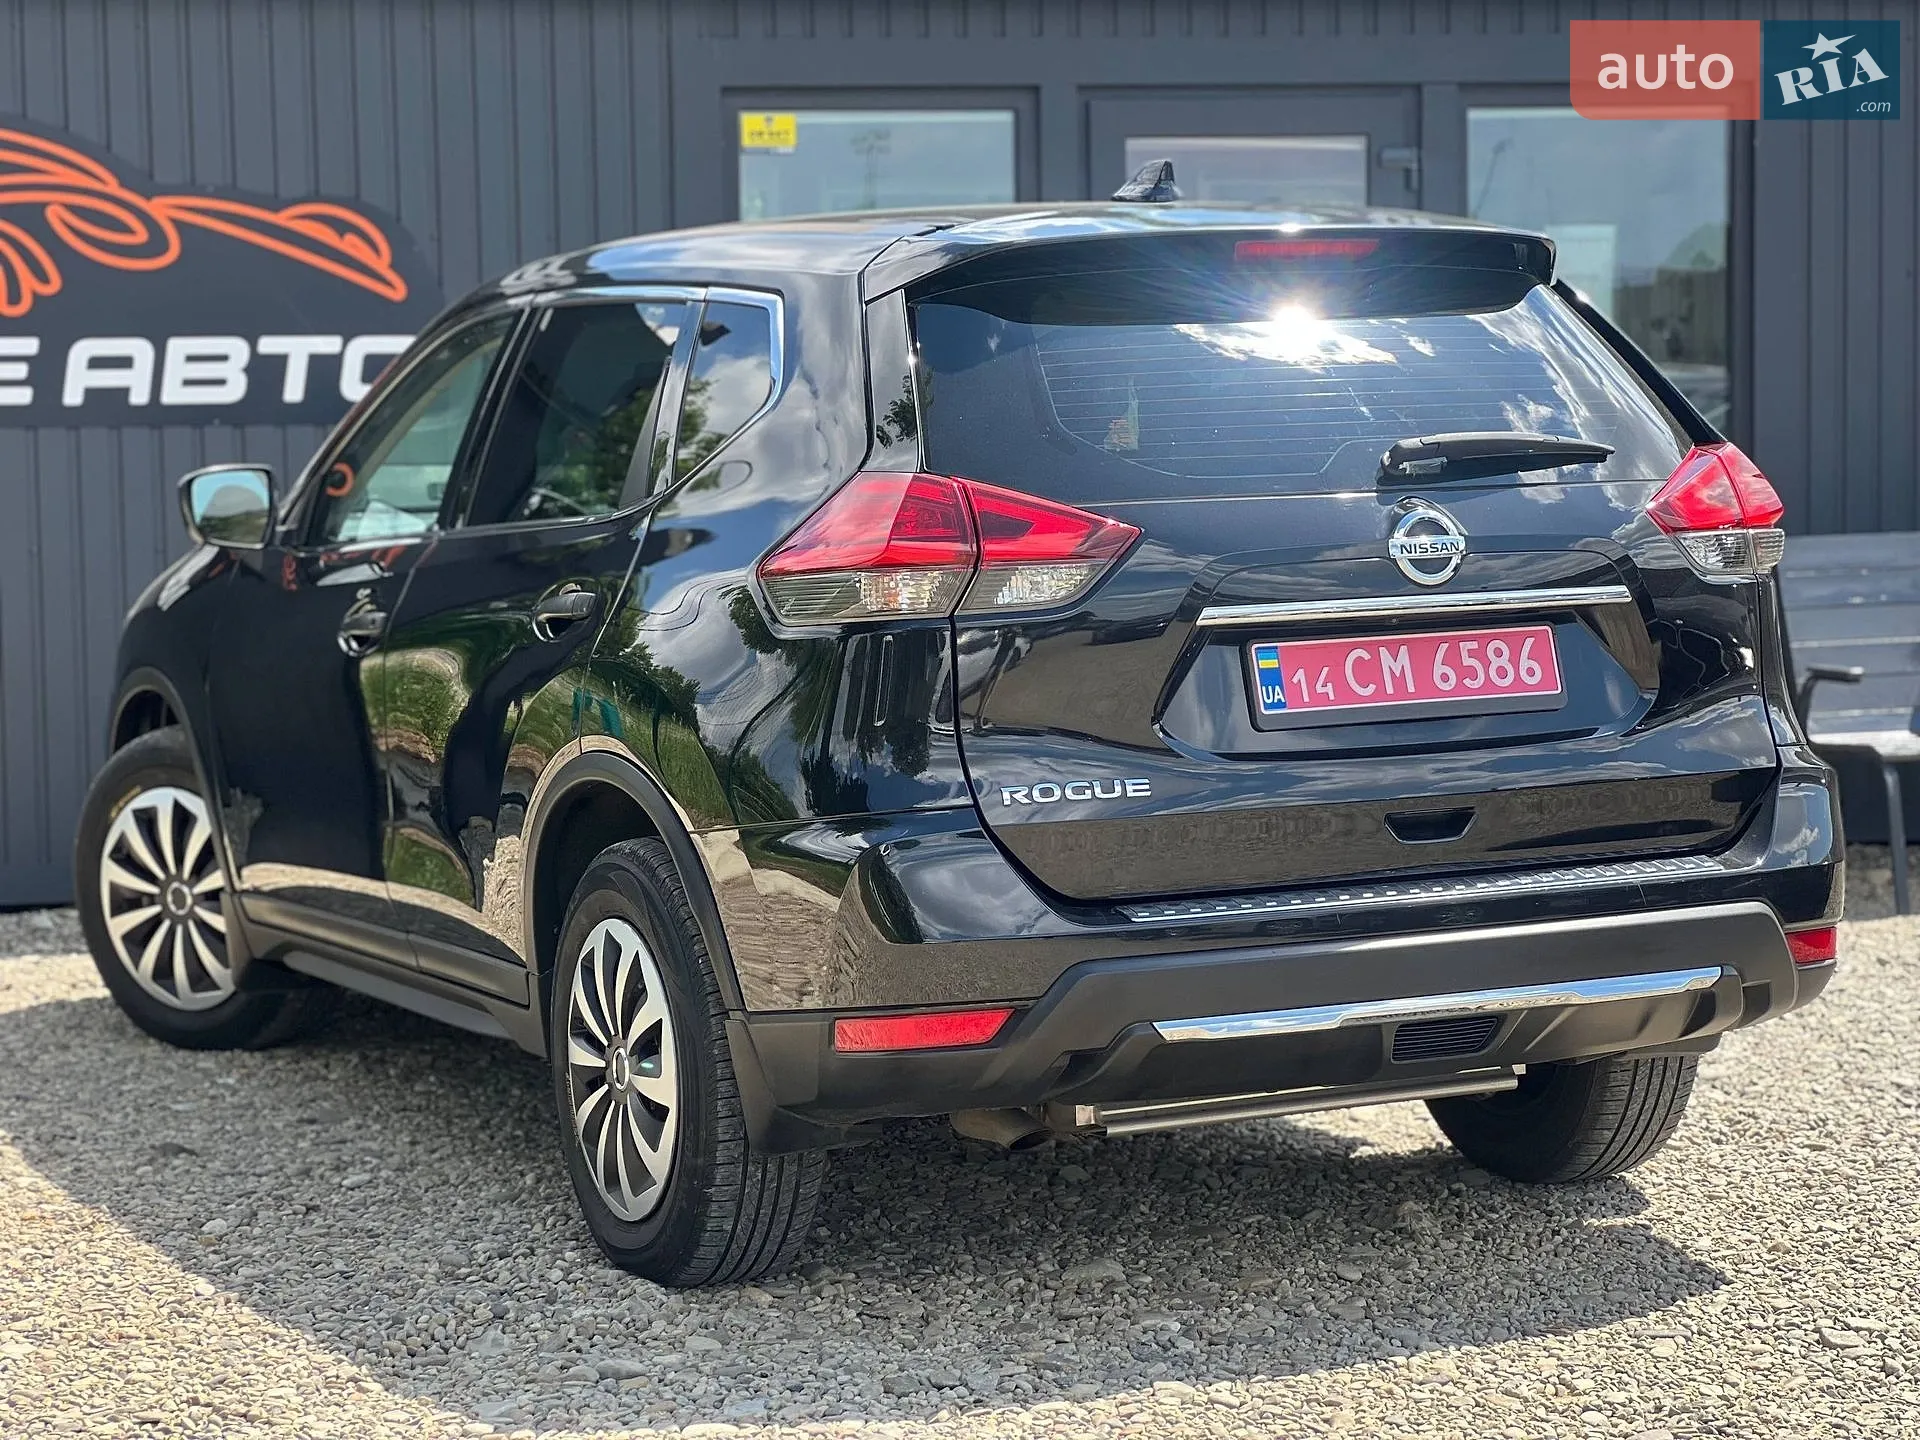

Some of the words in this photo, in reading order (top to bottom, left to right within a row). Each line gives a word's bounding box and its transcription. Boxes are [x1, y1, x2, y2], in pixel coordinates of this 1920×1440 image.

[1399, 540, 1461, 556] NISSAN
[1291, 666, 1336, 703] 14
[1343, 644, 1416, 697] CM
[1431, 636, 1543, 692] 6586
[1261, 684, 1286, 705] UA
[1000, 777, 1152, 807] ROGUE
